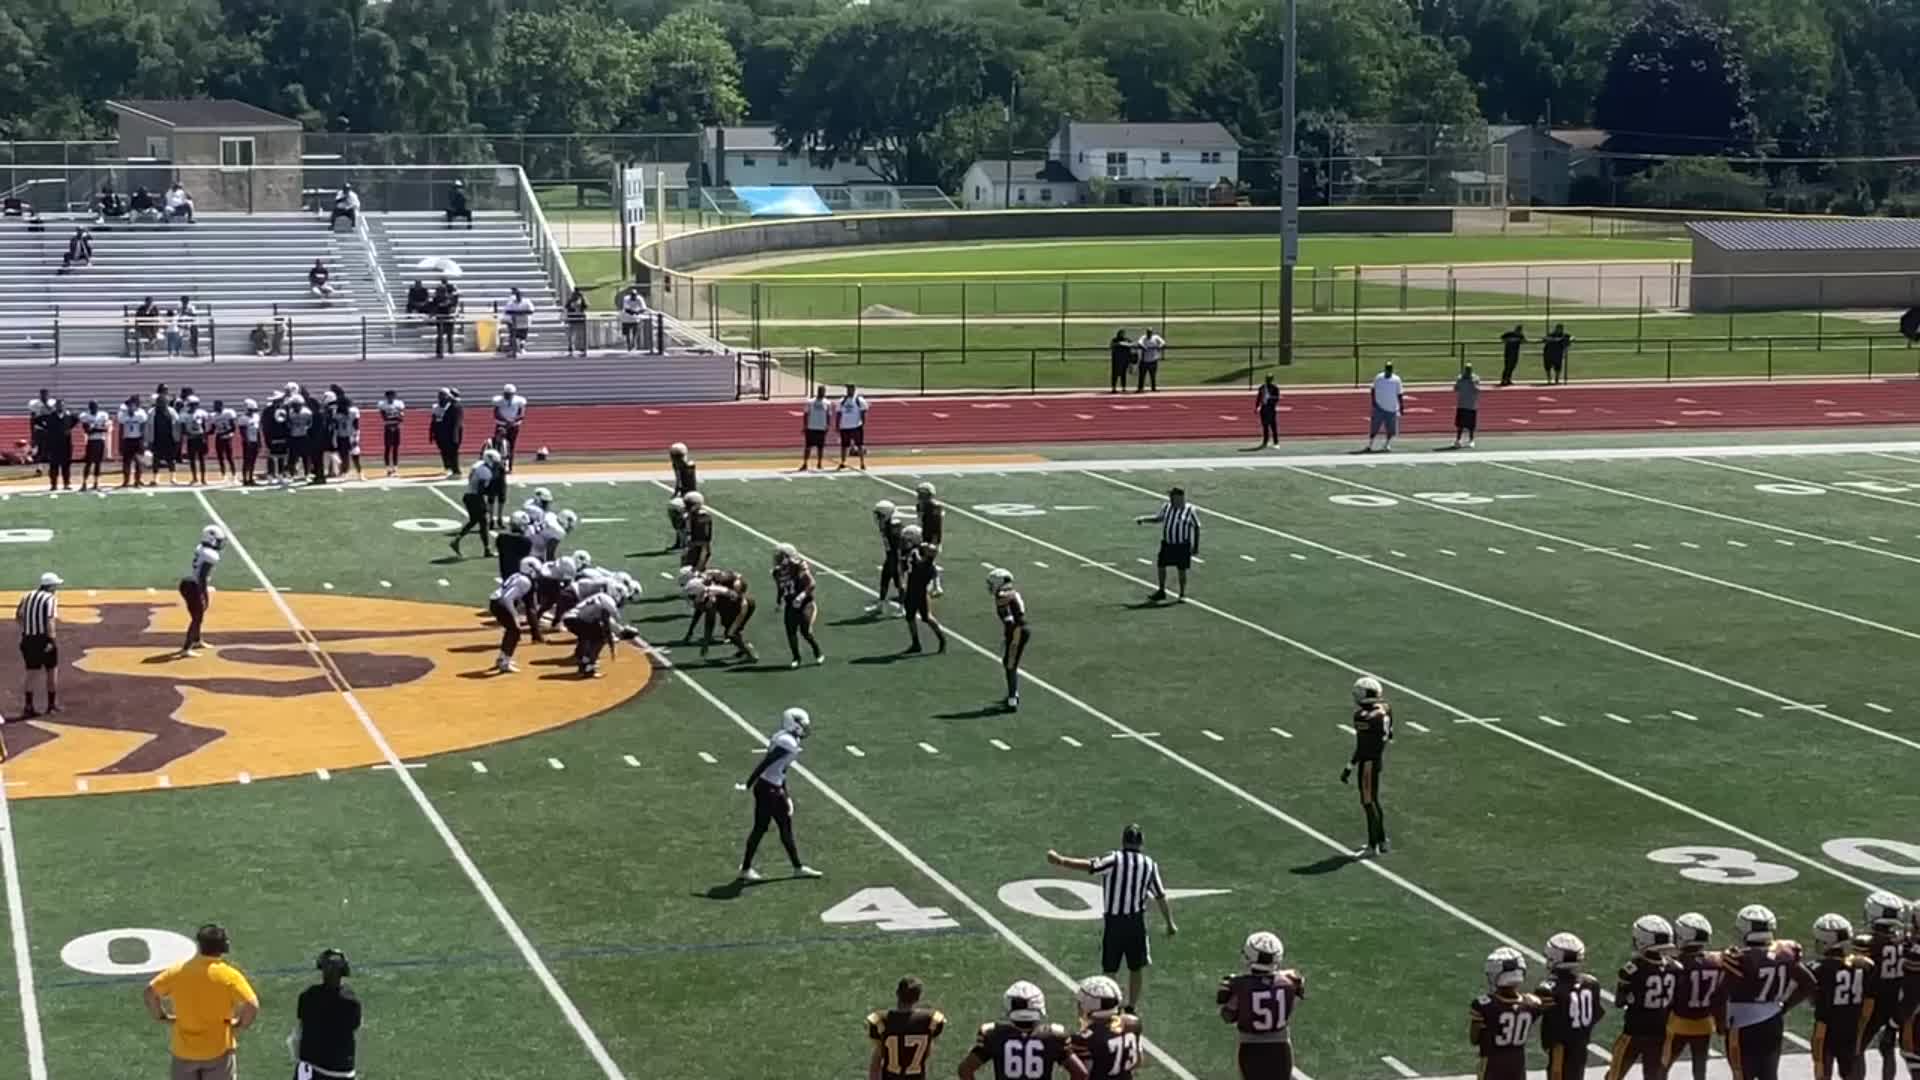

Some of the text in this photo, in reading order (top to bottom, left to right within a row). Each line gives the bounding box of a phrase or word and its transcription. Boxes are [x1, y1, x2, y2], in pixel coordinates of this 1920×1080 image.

[1643, 973, 1677, 1009] 23
[1688, 969, 1719, 1009] 17
[1755, 965, 1788, 1003] 71
[1833, 968, 1864, 1006] 24
[1252, 989, 1287, 1031] 51
[1568, 988, 1594, 1029] 40
[1495, 1011, 1533, 1047] 30
[884, 1034, 930, 1075] 17
[1003, 1039, 1045, 1079] 66
[1108, 1033, 1139, 1076] 73
